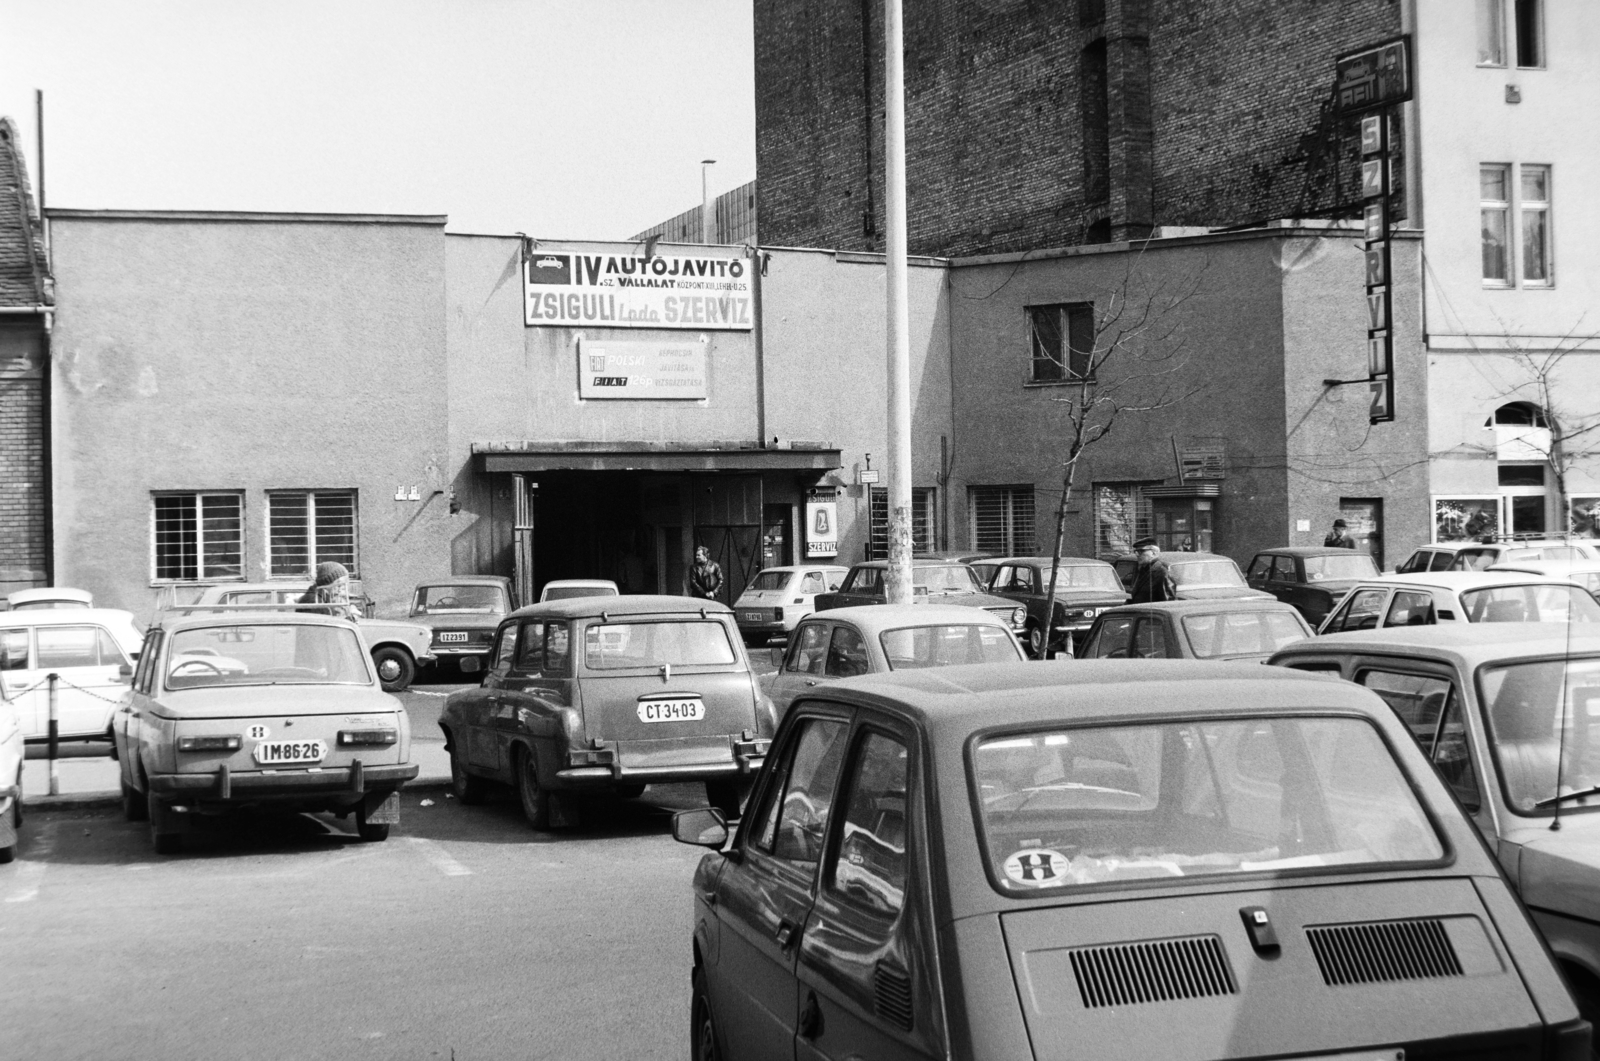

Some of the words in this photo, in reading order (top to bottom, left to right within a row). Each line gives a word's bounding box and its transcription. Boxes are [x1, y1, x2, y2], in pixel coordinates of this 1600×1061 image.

[1362, 117, 1384, 416] SZERVIZ
[530, 292, 616, 321] ZSIGULI
[619, 303, 661, 322] Lada
[664, 296, 750, 324] SZERVIZ
[608, 355, 646, 366] POLSKI
[594, 377, 628, 386] FIAT
[629, 375, 653, 388] 126p
[808, 542, 837, 552] SZERVIZ
[252, 726, 264, 738] H
[1017, 853, 1057, 880] H
